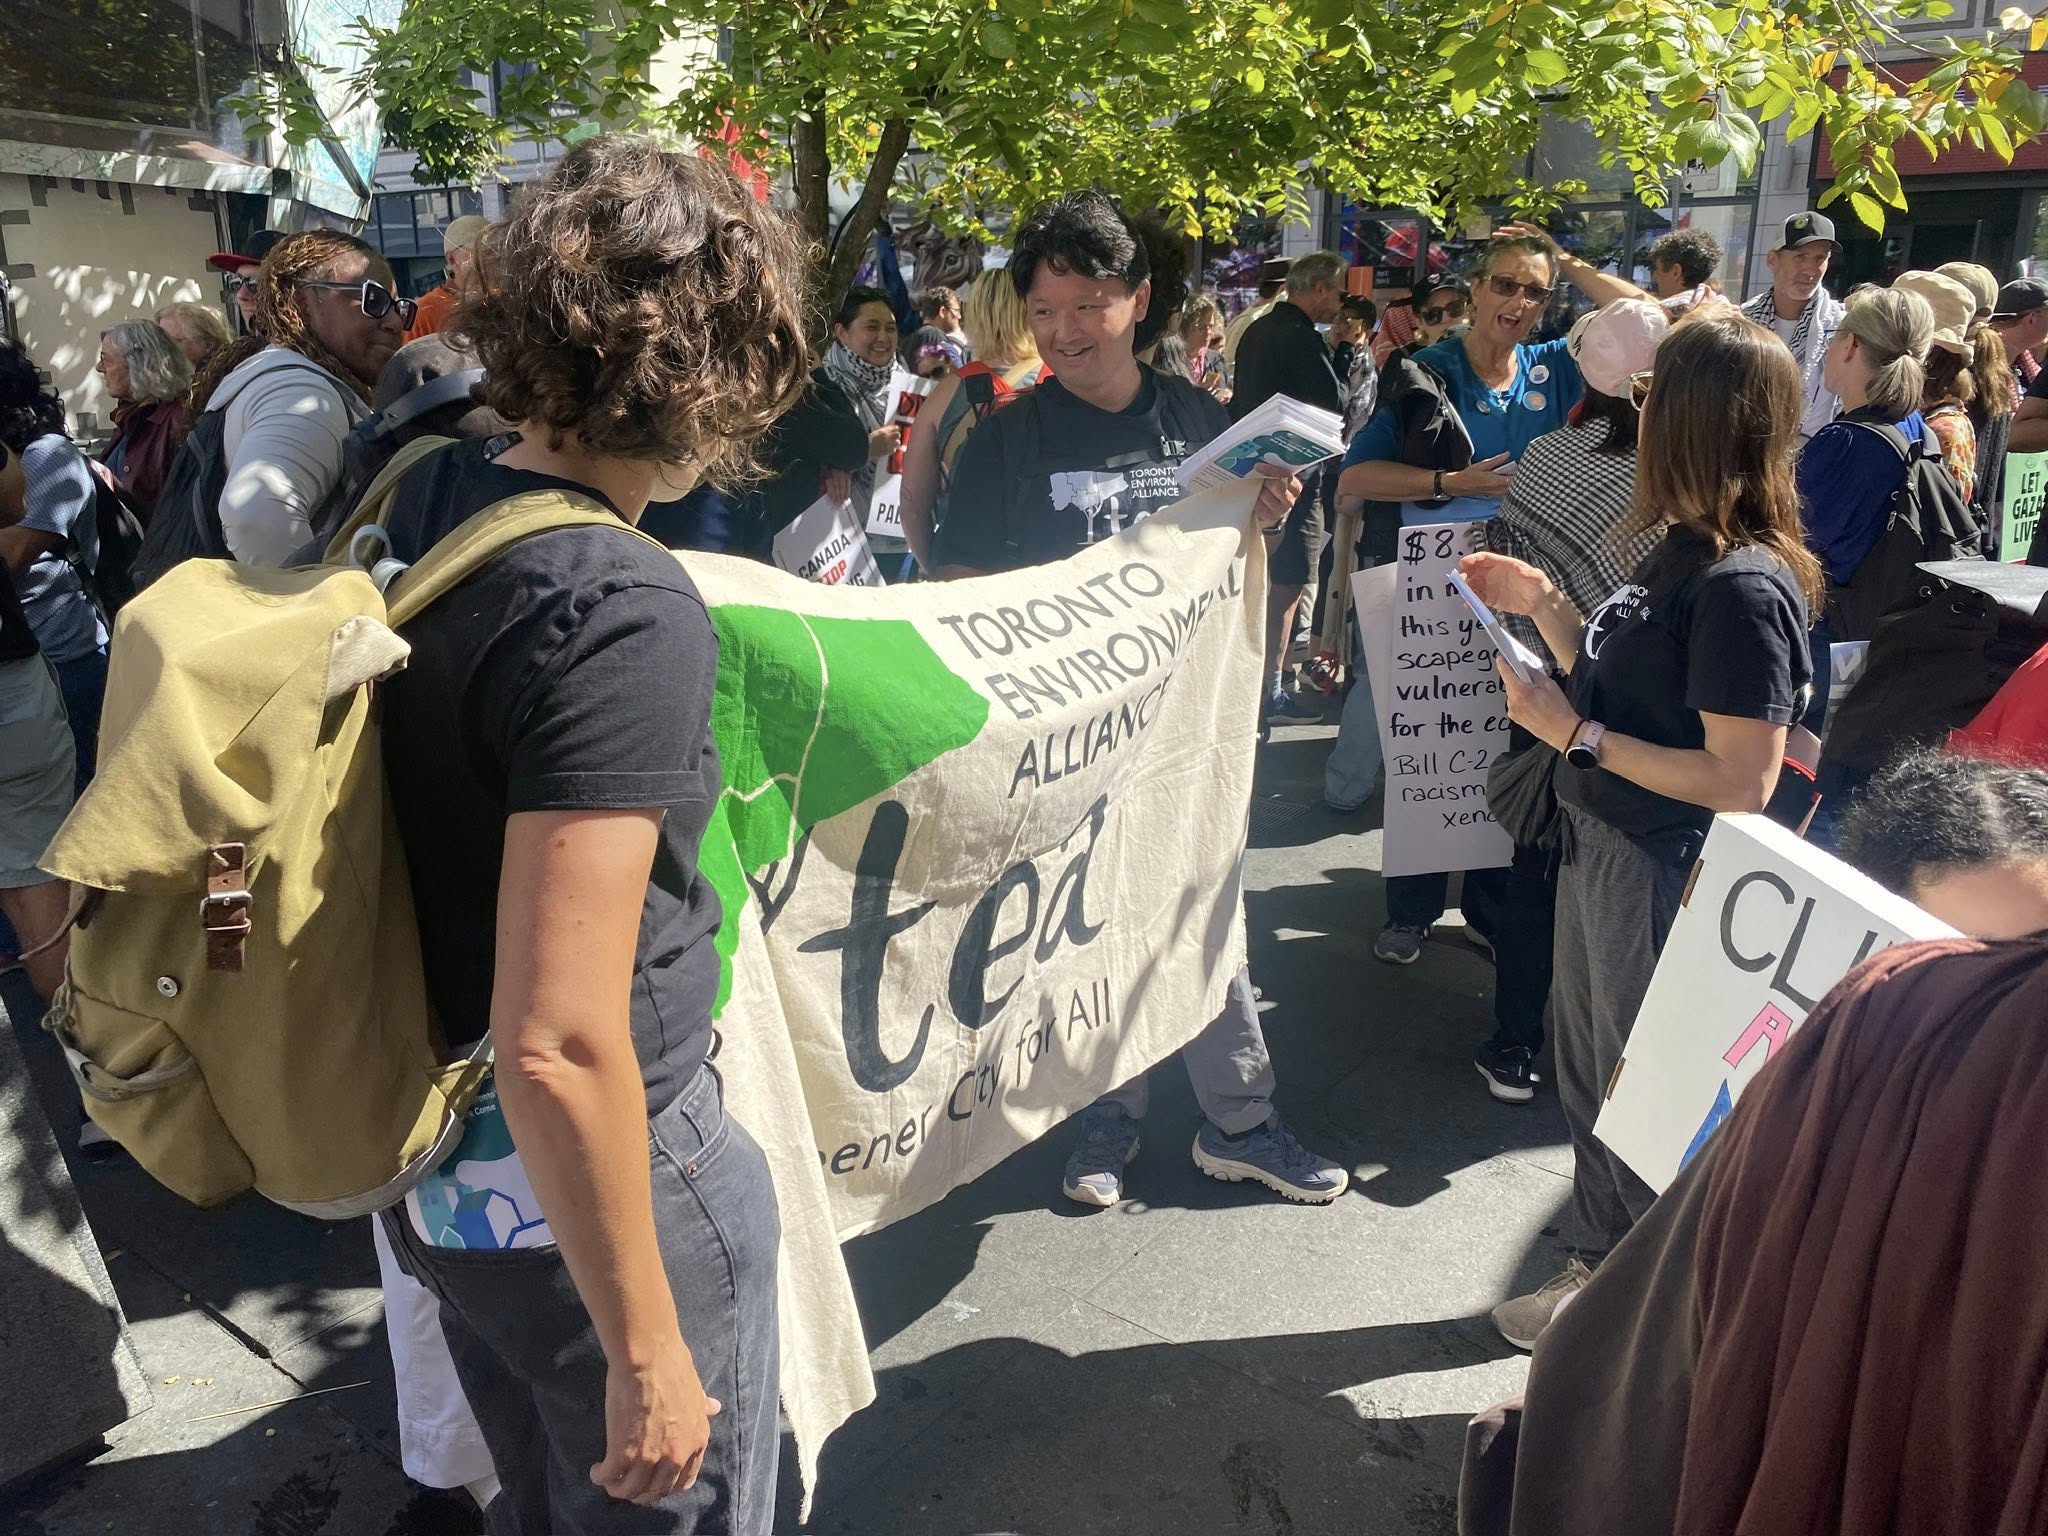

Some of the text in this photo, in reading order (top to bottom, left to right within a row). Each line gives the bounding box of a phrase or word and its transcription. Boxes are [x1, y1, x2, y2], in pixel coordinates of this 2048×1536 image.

[1131, 476, 1178, 489] ENVIRON
[1132, 487, 1180, 499] ALLIANCE
[2021, 471, 2041, 494] LET
[2012, 494, 2042, 520] GAZA
[798, 533, 851, 579] CANADA
[818, 559, 847, 585] TOP
[1407, 576, 1434, 603] in
[937, 562, 1165, 660] TORONTO
[1400, 615, 1450, 638] this
[1390, 712, 1427, 738] for
[1436, 711, 1474, 739] the
[1393, 749, 1489, 776] Bill C-2
[1402, 782, 1486, 802] racism
[818, 976, 1111, 1175] ener City for All
